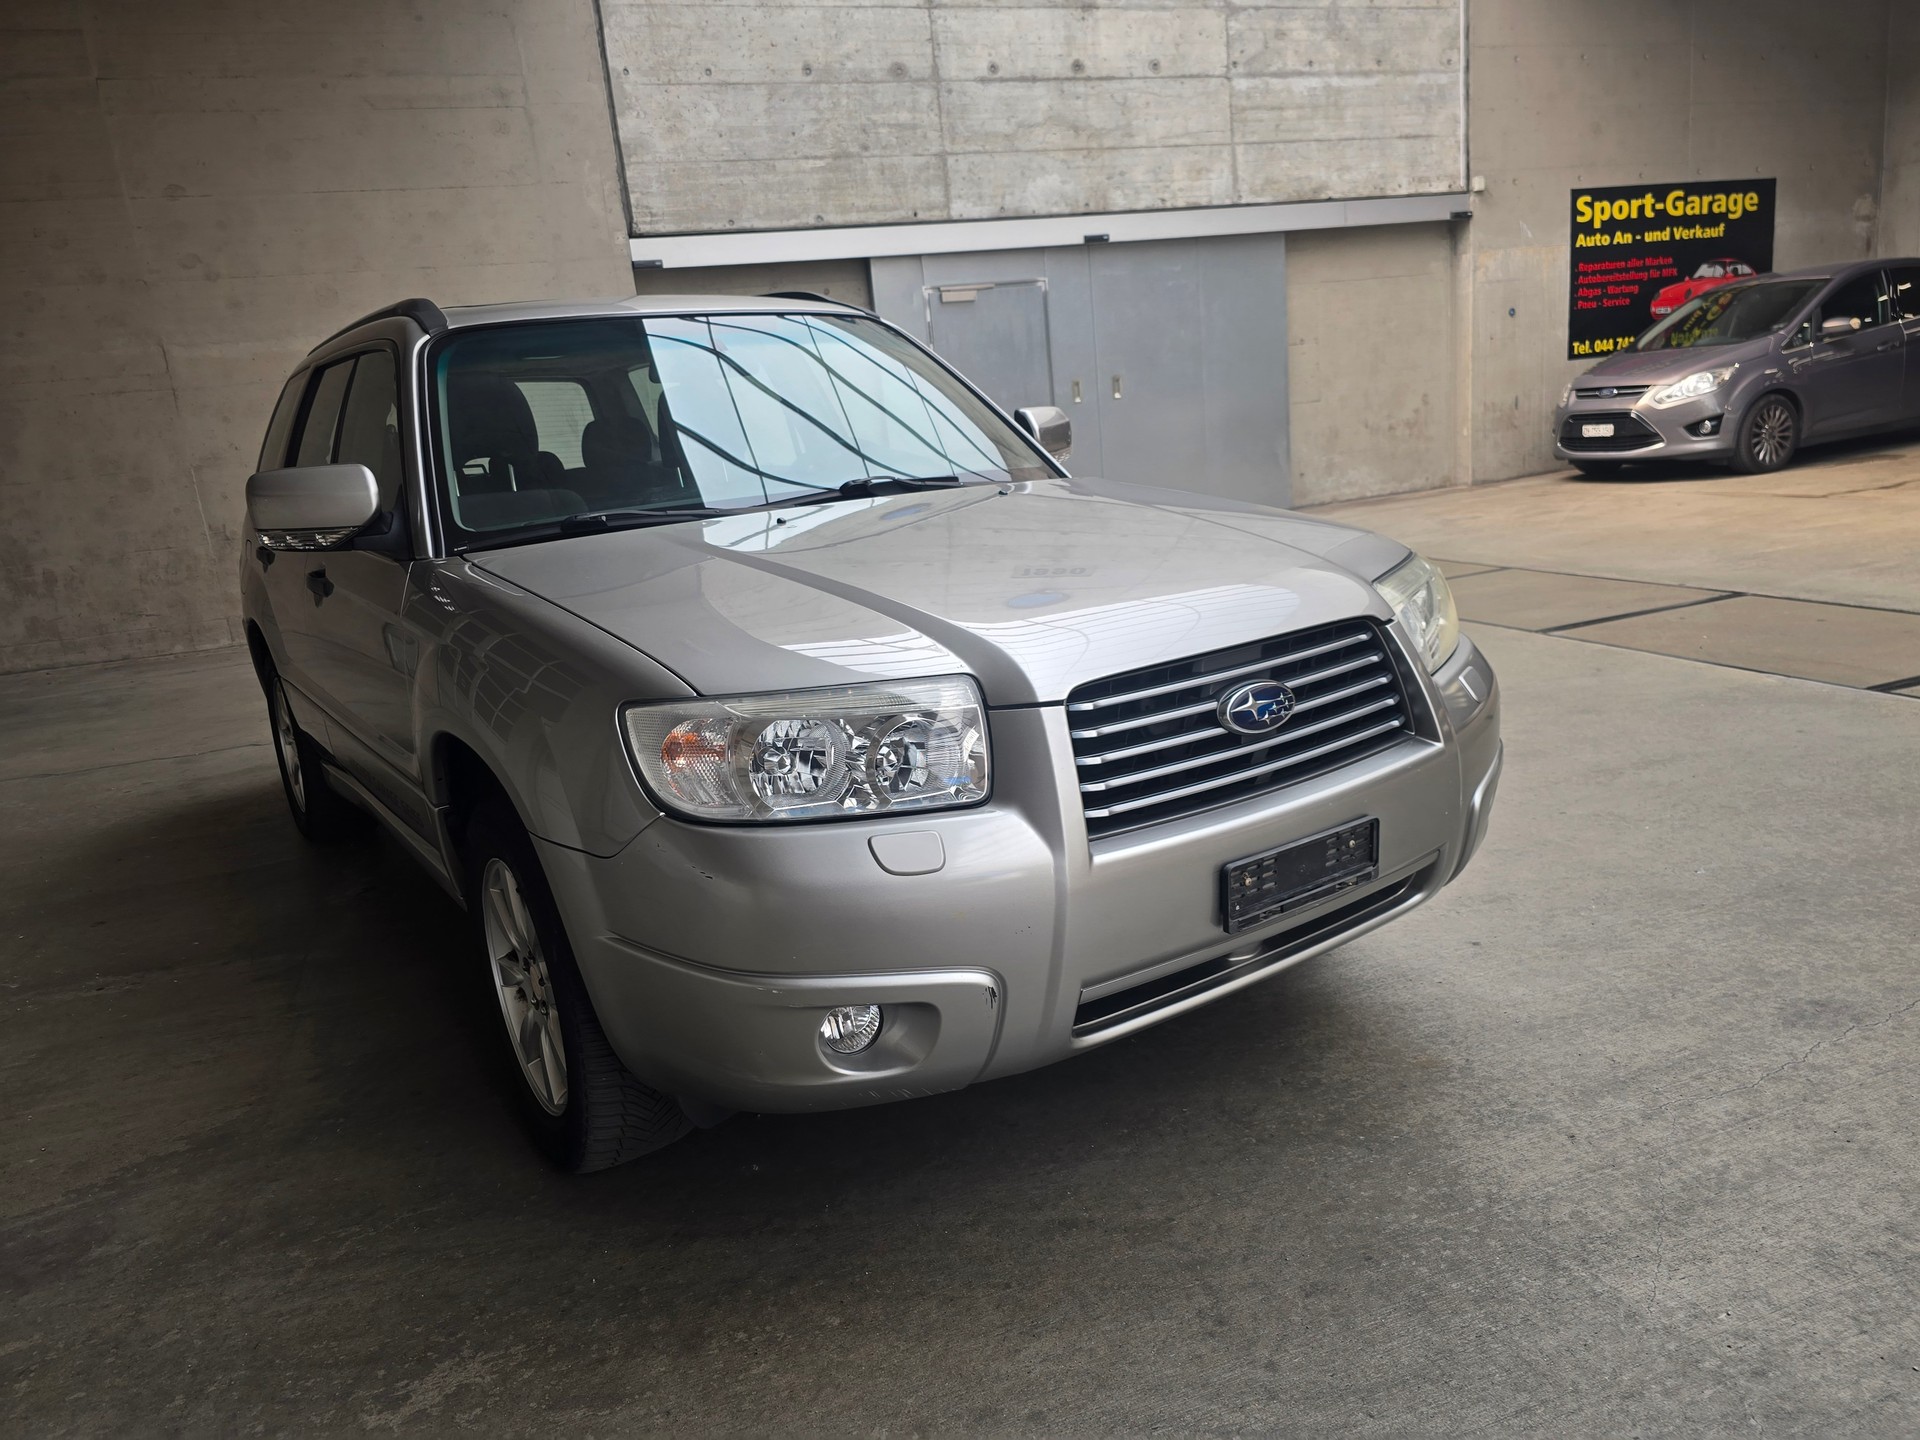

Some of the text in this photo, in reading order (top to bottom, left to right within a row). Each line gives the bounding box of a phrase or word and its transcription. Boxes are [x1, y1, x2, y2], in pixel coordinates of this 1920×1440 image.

[1576, 190, 1759, 229] Sport-Garage
[1575, 231, 1610, 247] Auto
[1613, 230, 1632, 245] An
[1644, 227, 1670, 243] und
[1673, 223, 1725, 240] Verkauf
[1578, 256, 1673, 272] Reparaturen aller Marken
[1577, 287, 1601, 298] Abgas
[1606, 285, 1639, 295] Wartung
[1577, 300, 1597, 310] Pneu
[1601, 298, 1630, 308] Service
[1573, 339, 1592, 354] Tel.
[1594, 337, 1614, 352] 044
